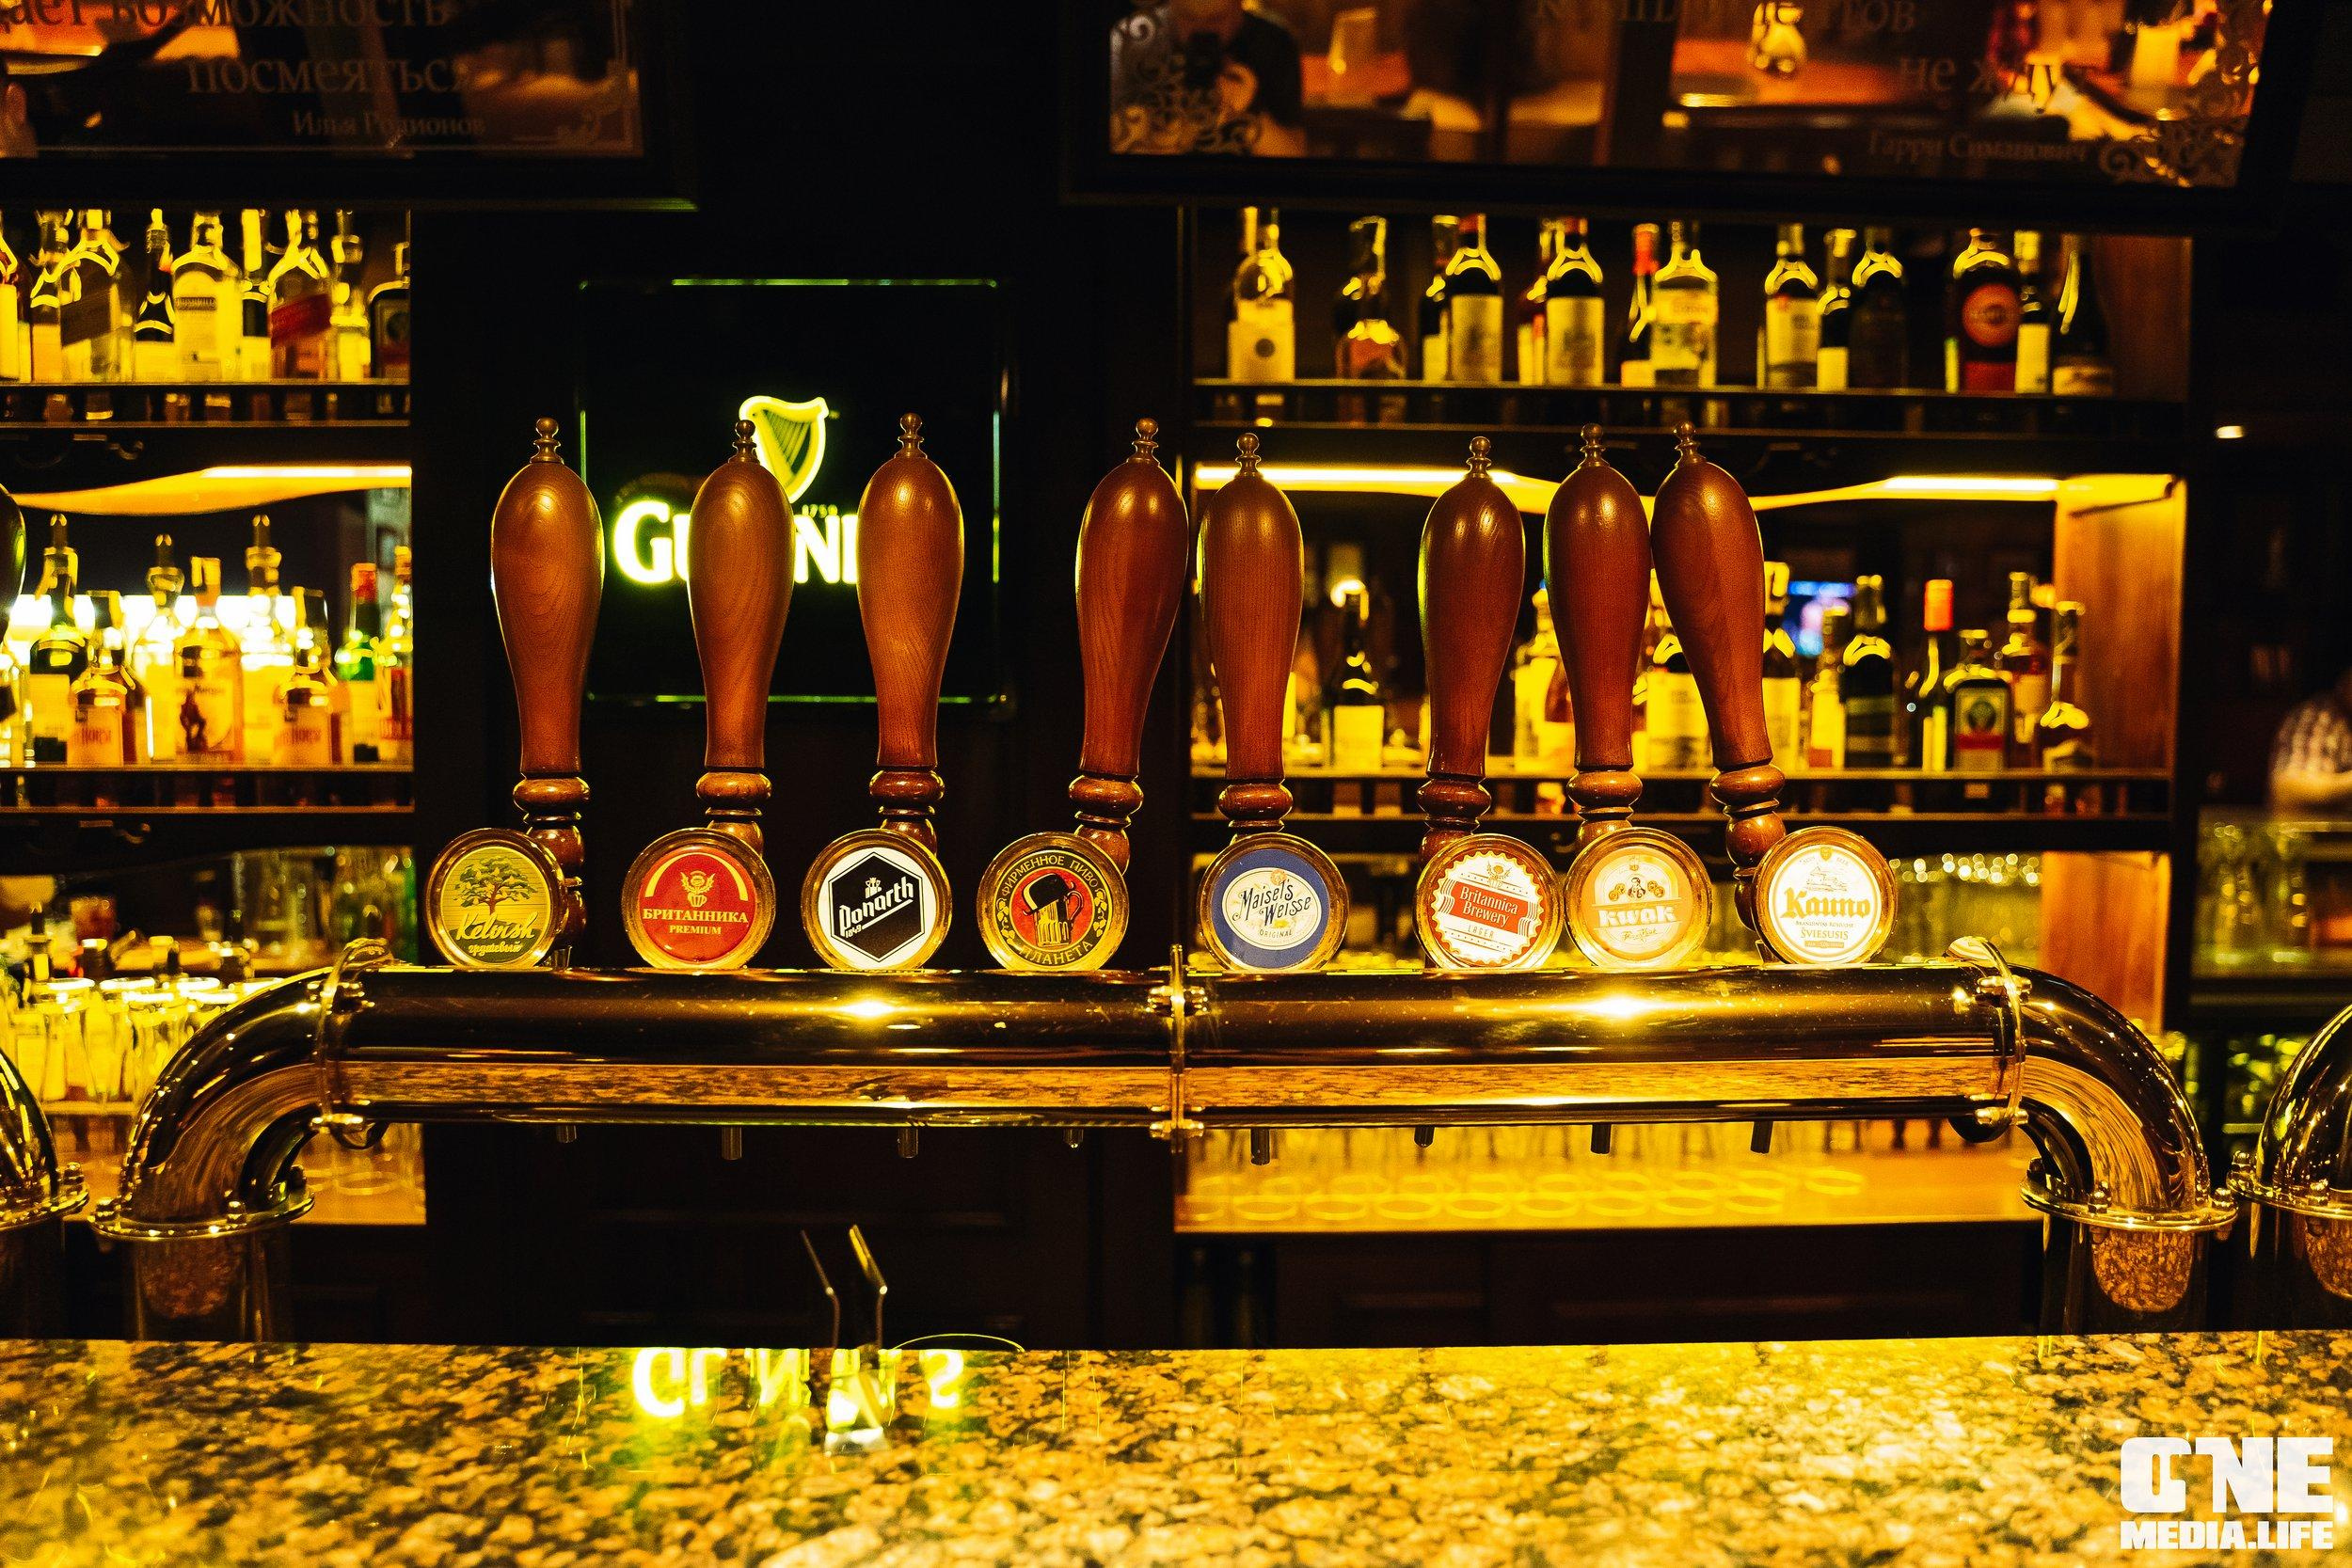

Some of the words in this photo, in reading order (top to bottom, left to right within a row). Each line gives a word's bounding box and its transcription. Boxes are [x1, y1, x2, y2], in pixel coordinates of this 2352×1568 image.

[1002, 855, 1064, 896] ФИРМЕННОЕ
[1070, 860, 1099, 888] ПИВО
[1259, 896, 1311, 926] Weisse
[1459, 886, 1518, 915] Britannica
[643, 908, 749, 924] БРИТАННИКА
[1462, 901, 1510, 927] Brewery
[669, 925, 723, 935] PREMIUM
[1259, 928, 1293, 939] ORIGINAL
[1019, 941, 1094, 965] ПЛАНЕТА
